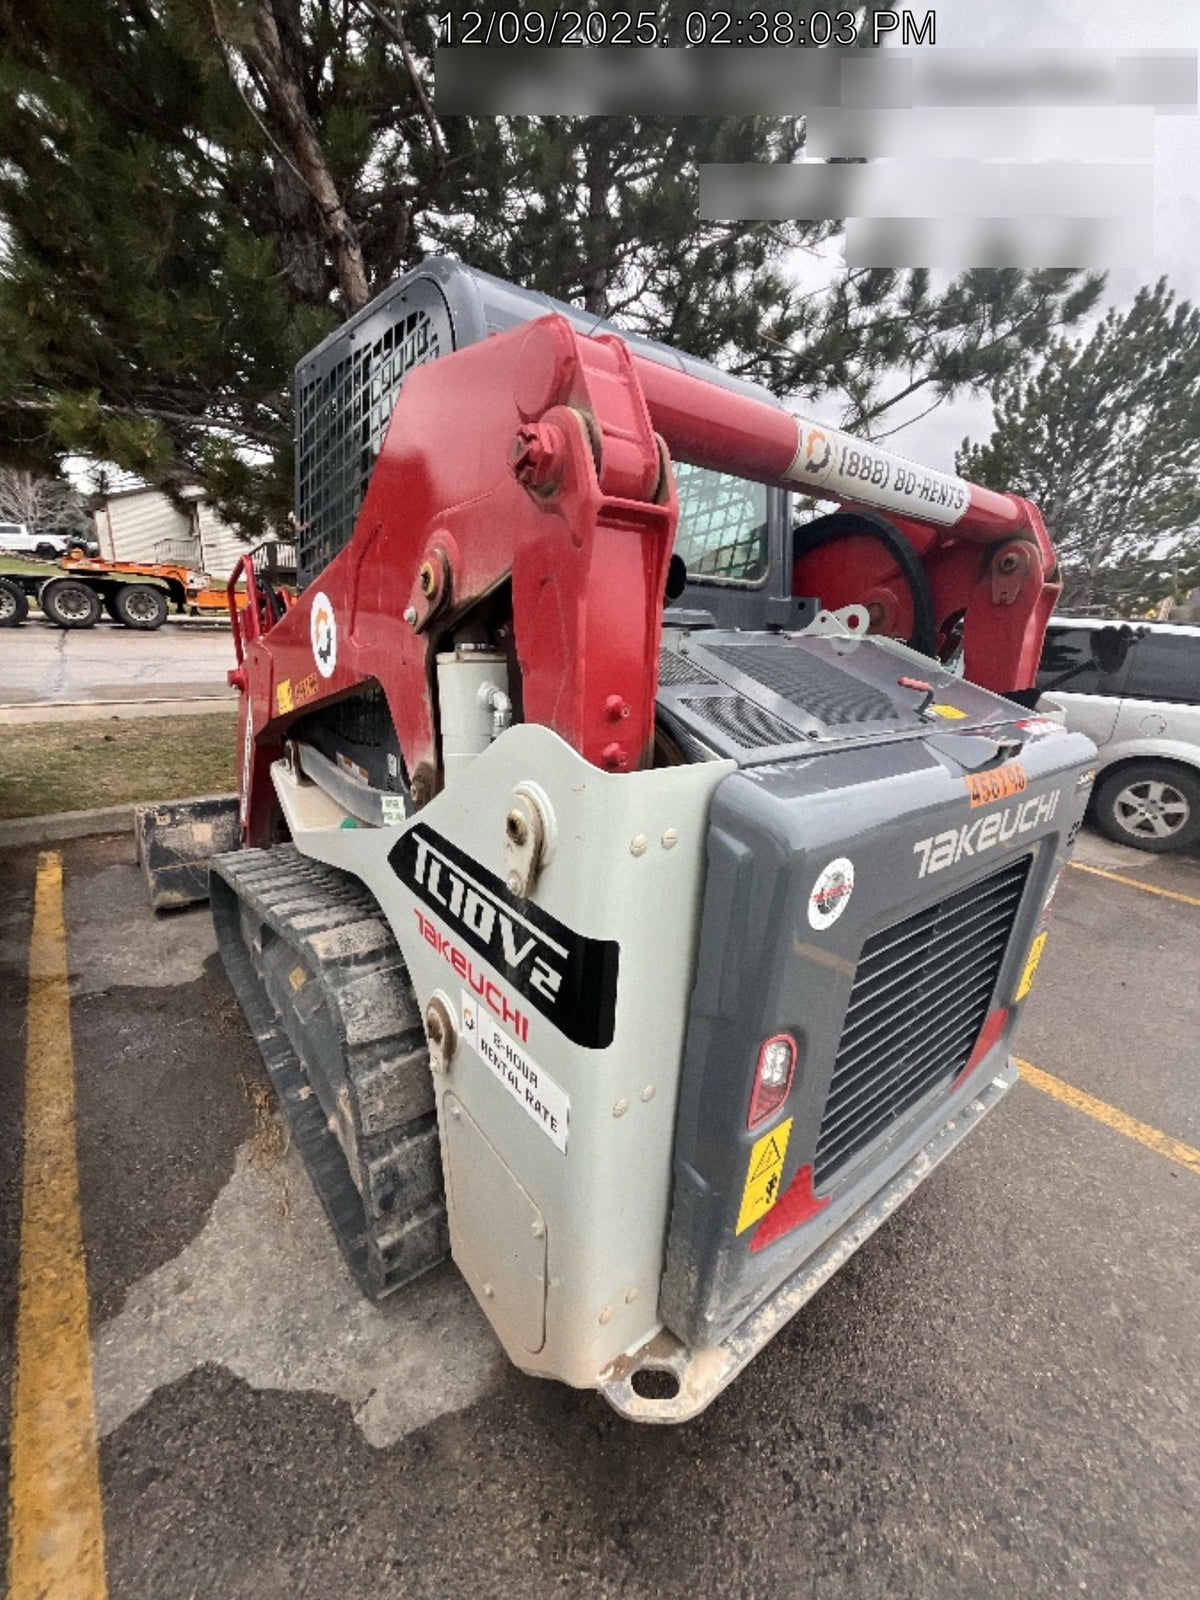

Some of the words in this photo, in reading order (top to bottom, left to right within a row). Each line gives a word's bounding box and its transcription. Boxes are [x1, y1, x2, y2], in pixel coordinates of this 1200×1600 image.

[971, 765, 1025, 804] 456196
[913, 789, 1061, 879] TAKEUCHI
[413, 908, 529, 1044] TAKEUCHI
[525, 1088, 559, 1134] RATE
